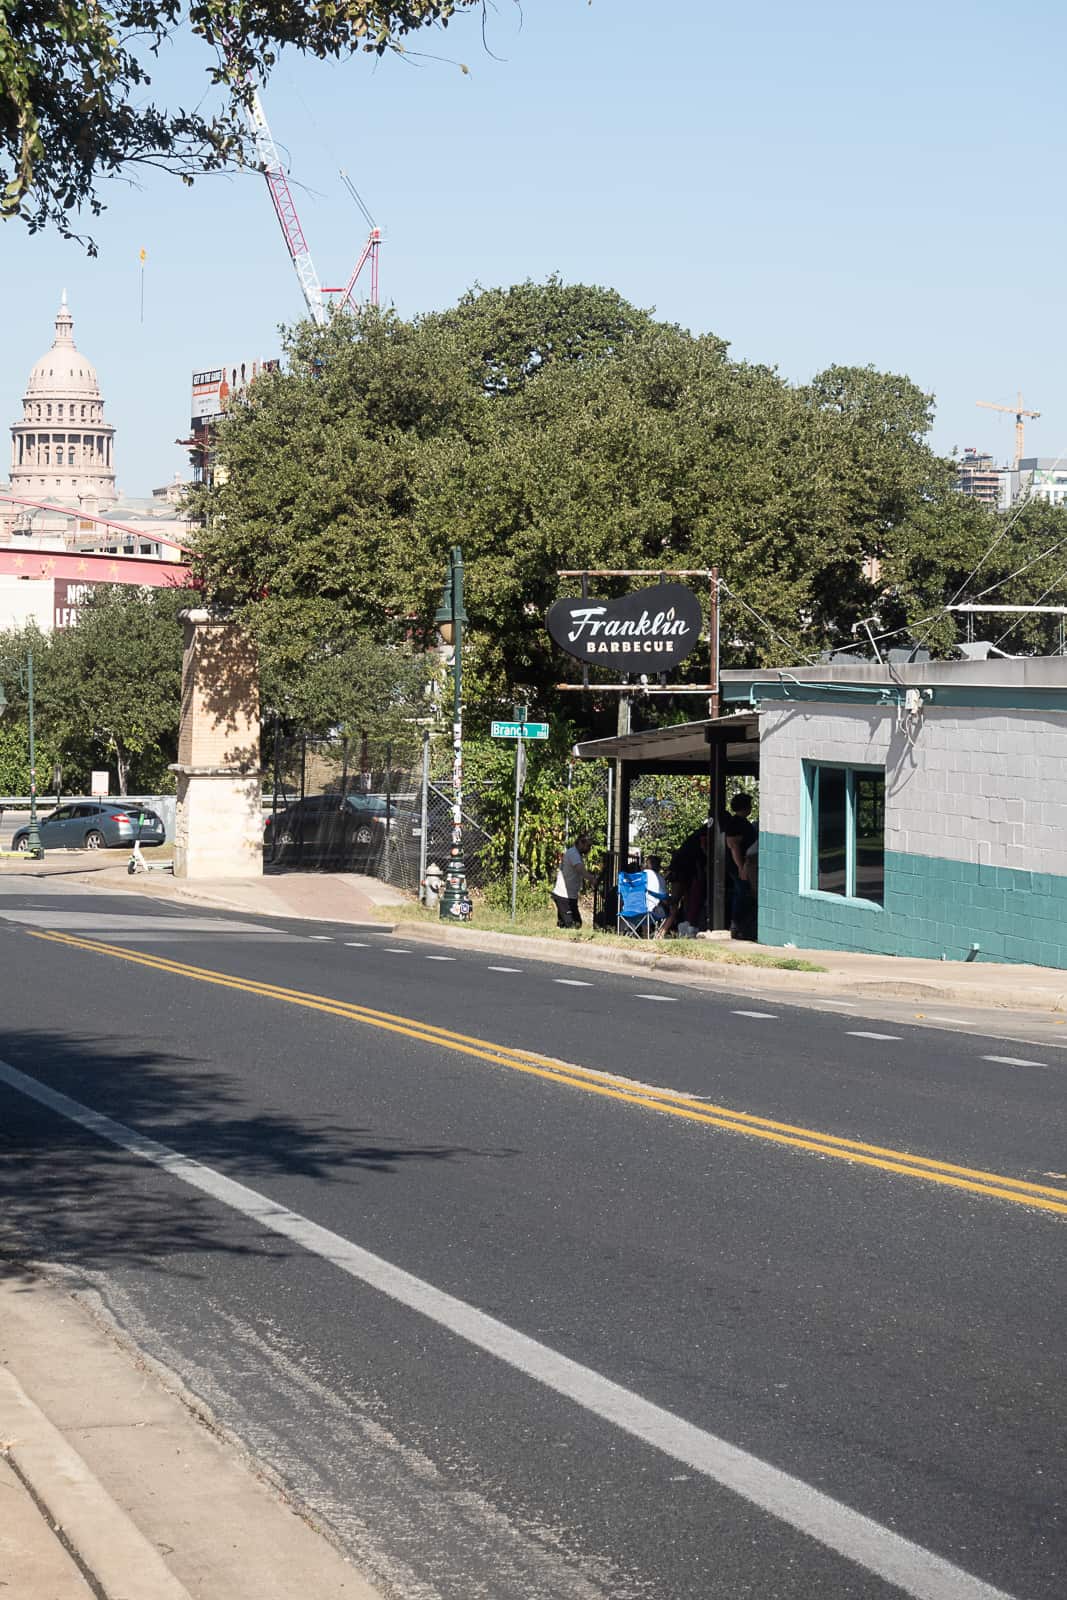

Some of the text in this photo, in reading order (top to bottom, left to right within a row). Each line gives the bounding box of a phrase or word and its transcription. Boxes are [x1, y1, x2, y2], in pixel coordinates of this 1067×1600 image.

[568, 606, 690, 642] Franklin
[586, 640, 674, 653] BARBECUE
[493, 723, 528, 737] Branch
